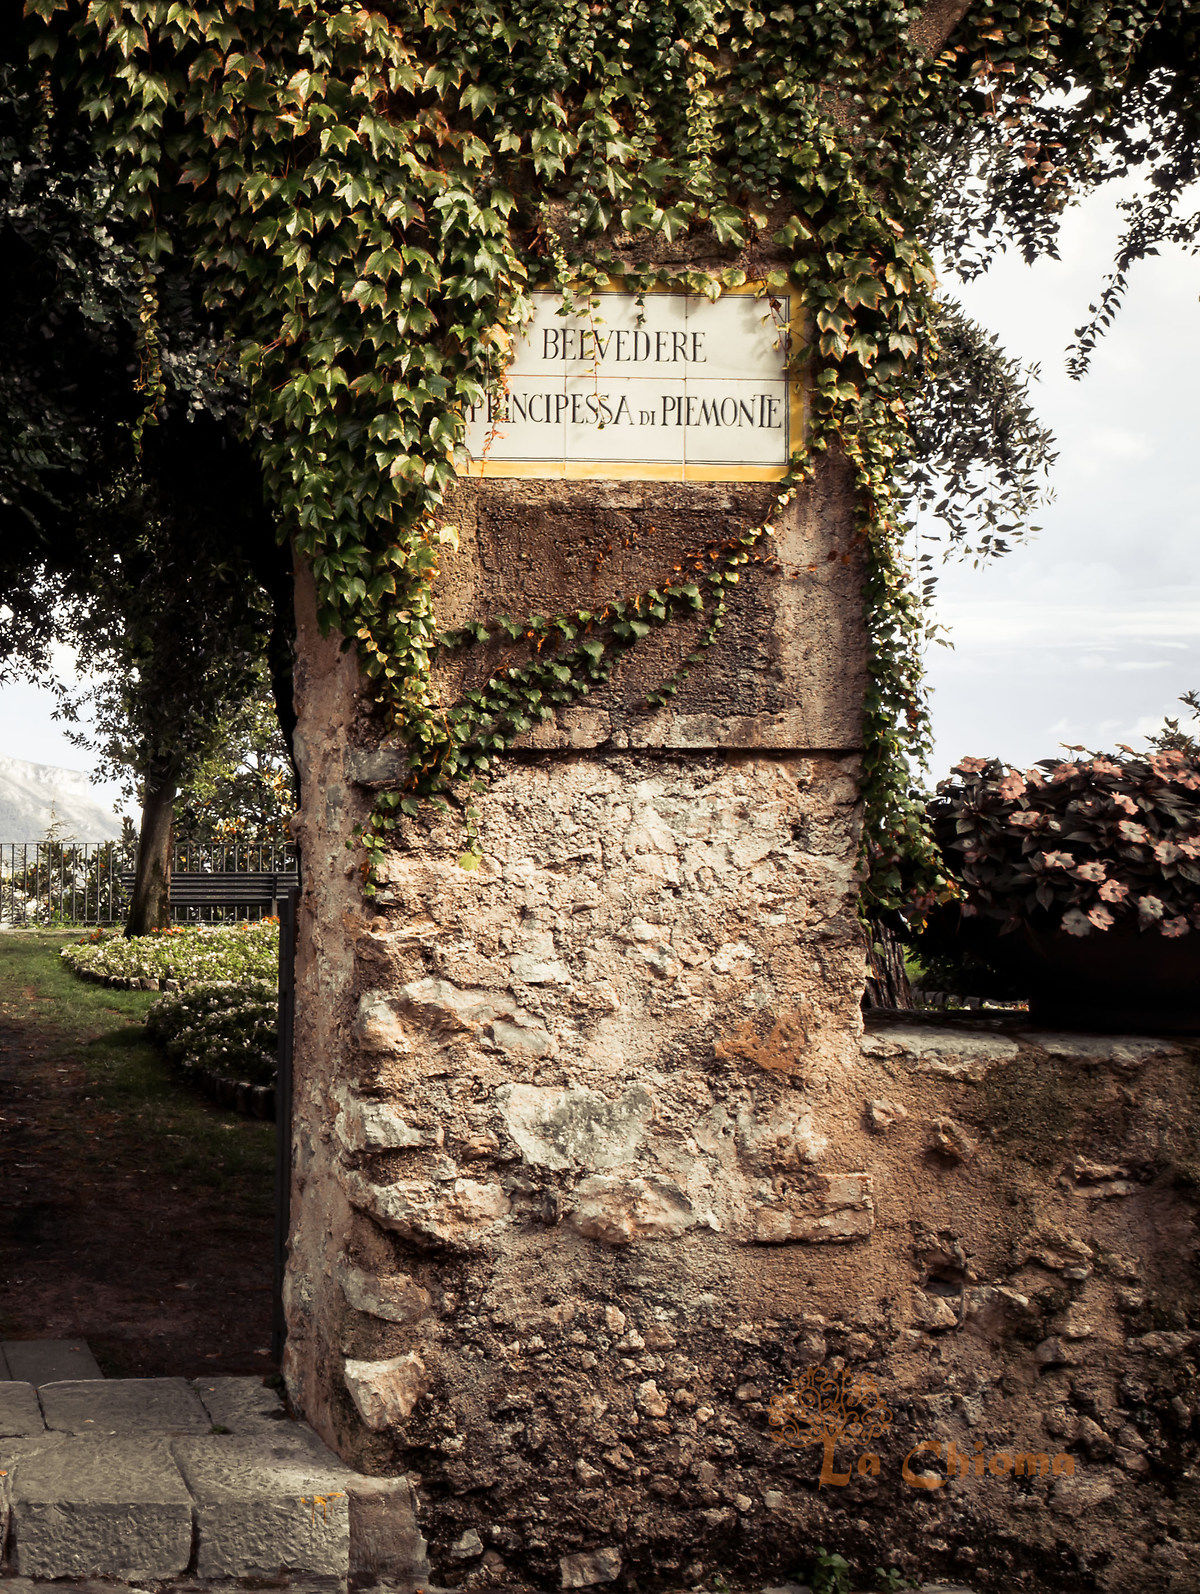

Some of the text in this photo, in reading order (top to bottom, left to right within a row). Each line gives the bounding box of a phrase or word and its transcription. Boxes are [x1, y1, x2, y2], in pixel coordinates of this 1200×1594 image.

[542, 328, 707, 363] BELVEDERE
[639, 410, 656, 426] DI
[661, 394, 782, 428] PIEMONTE
